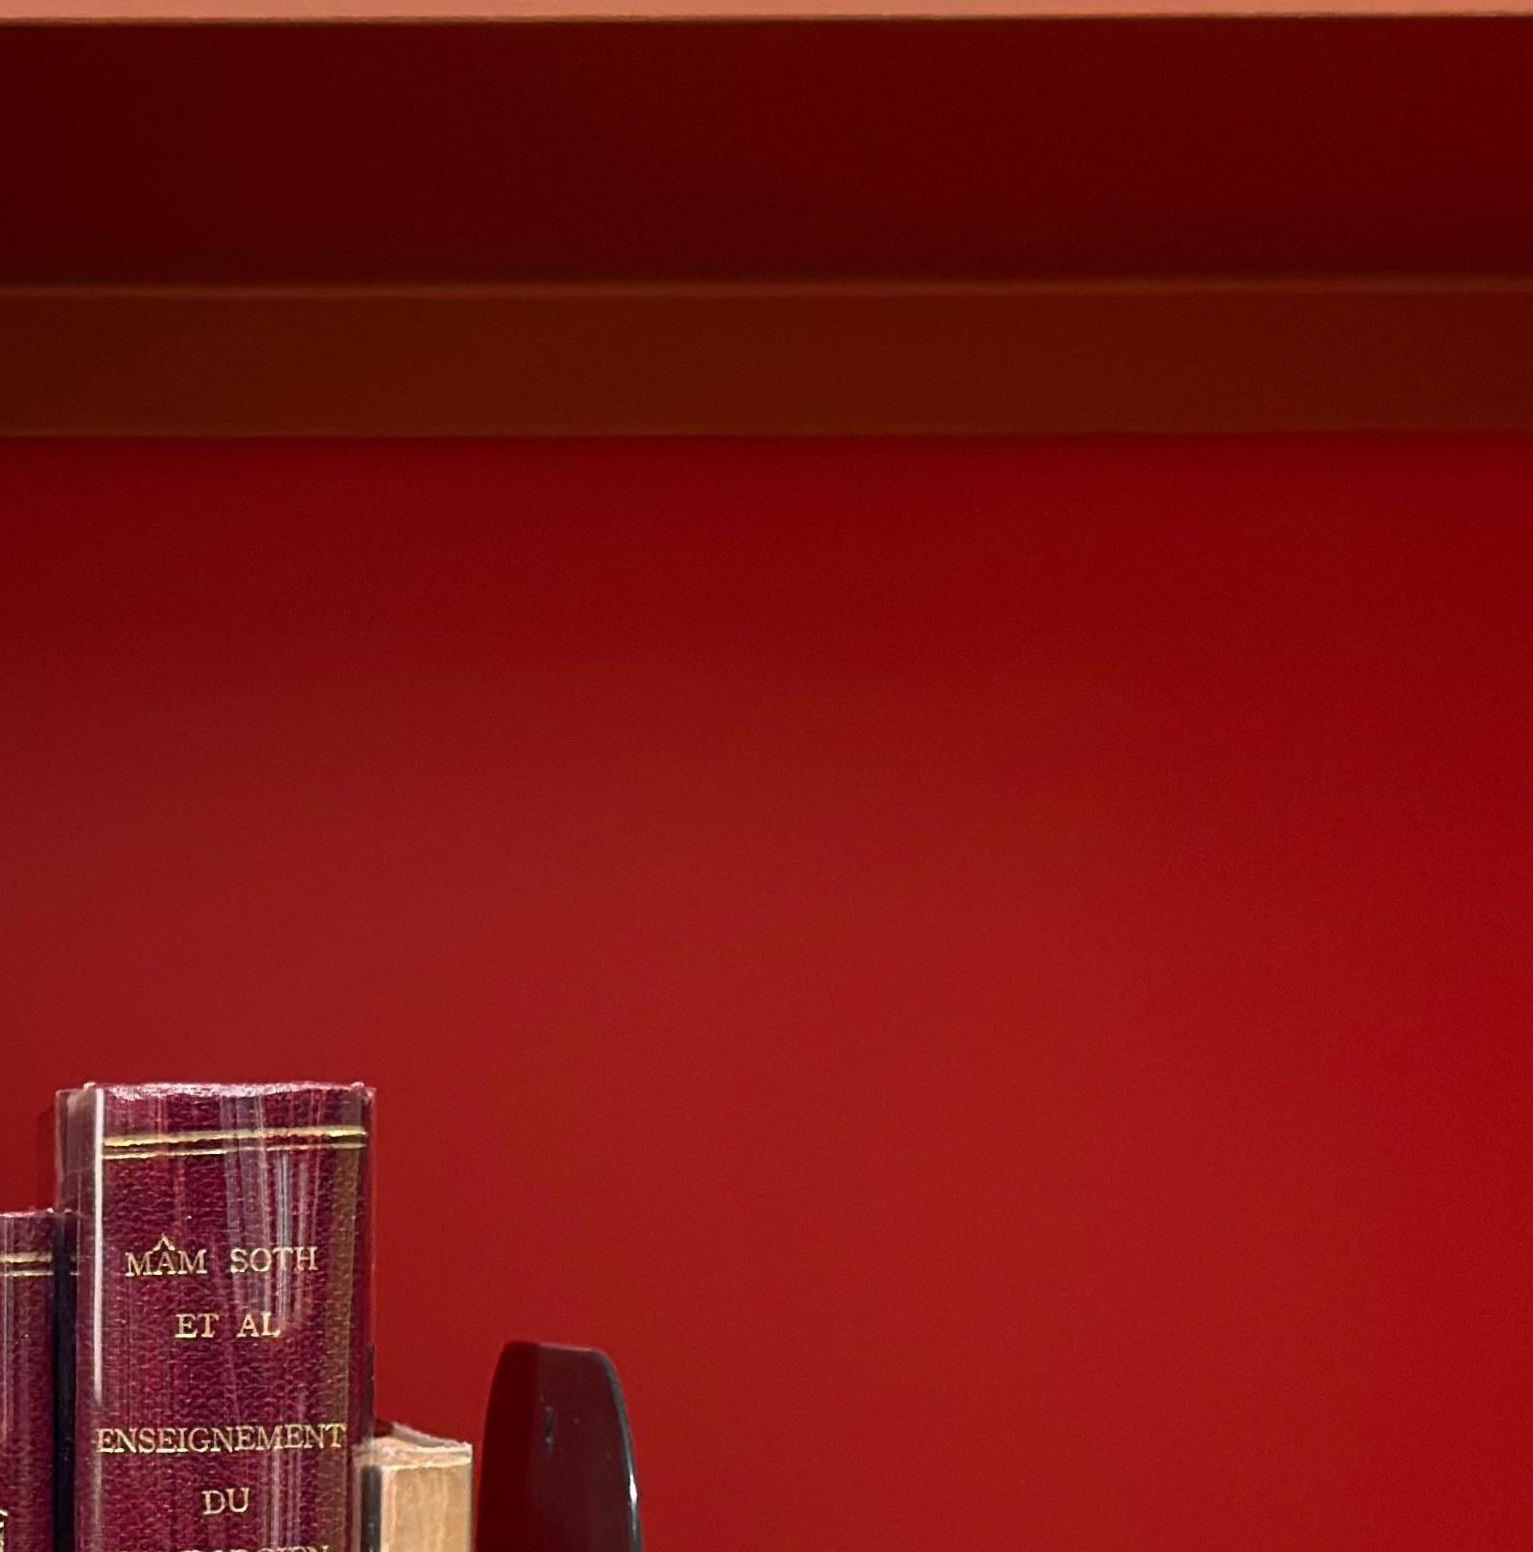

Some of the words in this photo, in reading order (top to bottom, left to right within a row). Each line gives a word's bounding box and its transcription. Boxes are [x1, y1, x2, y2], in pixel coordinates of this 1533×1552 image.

[125, 1233, 208, 1277] MÂM
[229, 1245, 319, 1275] SOTH
[175, 1313, 220, 1339] ET
[237, 1312, 281, 1338] AL
[95, 1423, 348, 1454] ENSEIGNEMENT
[202, 1487, 250, 1516] DU
